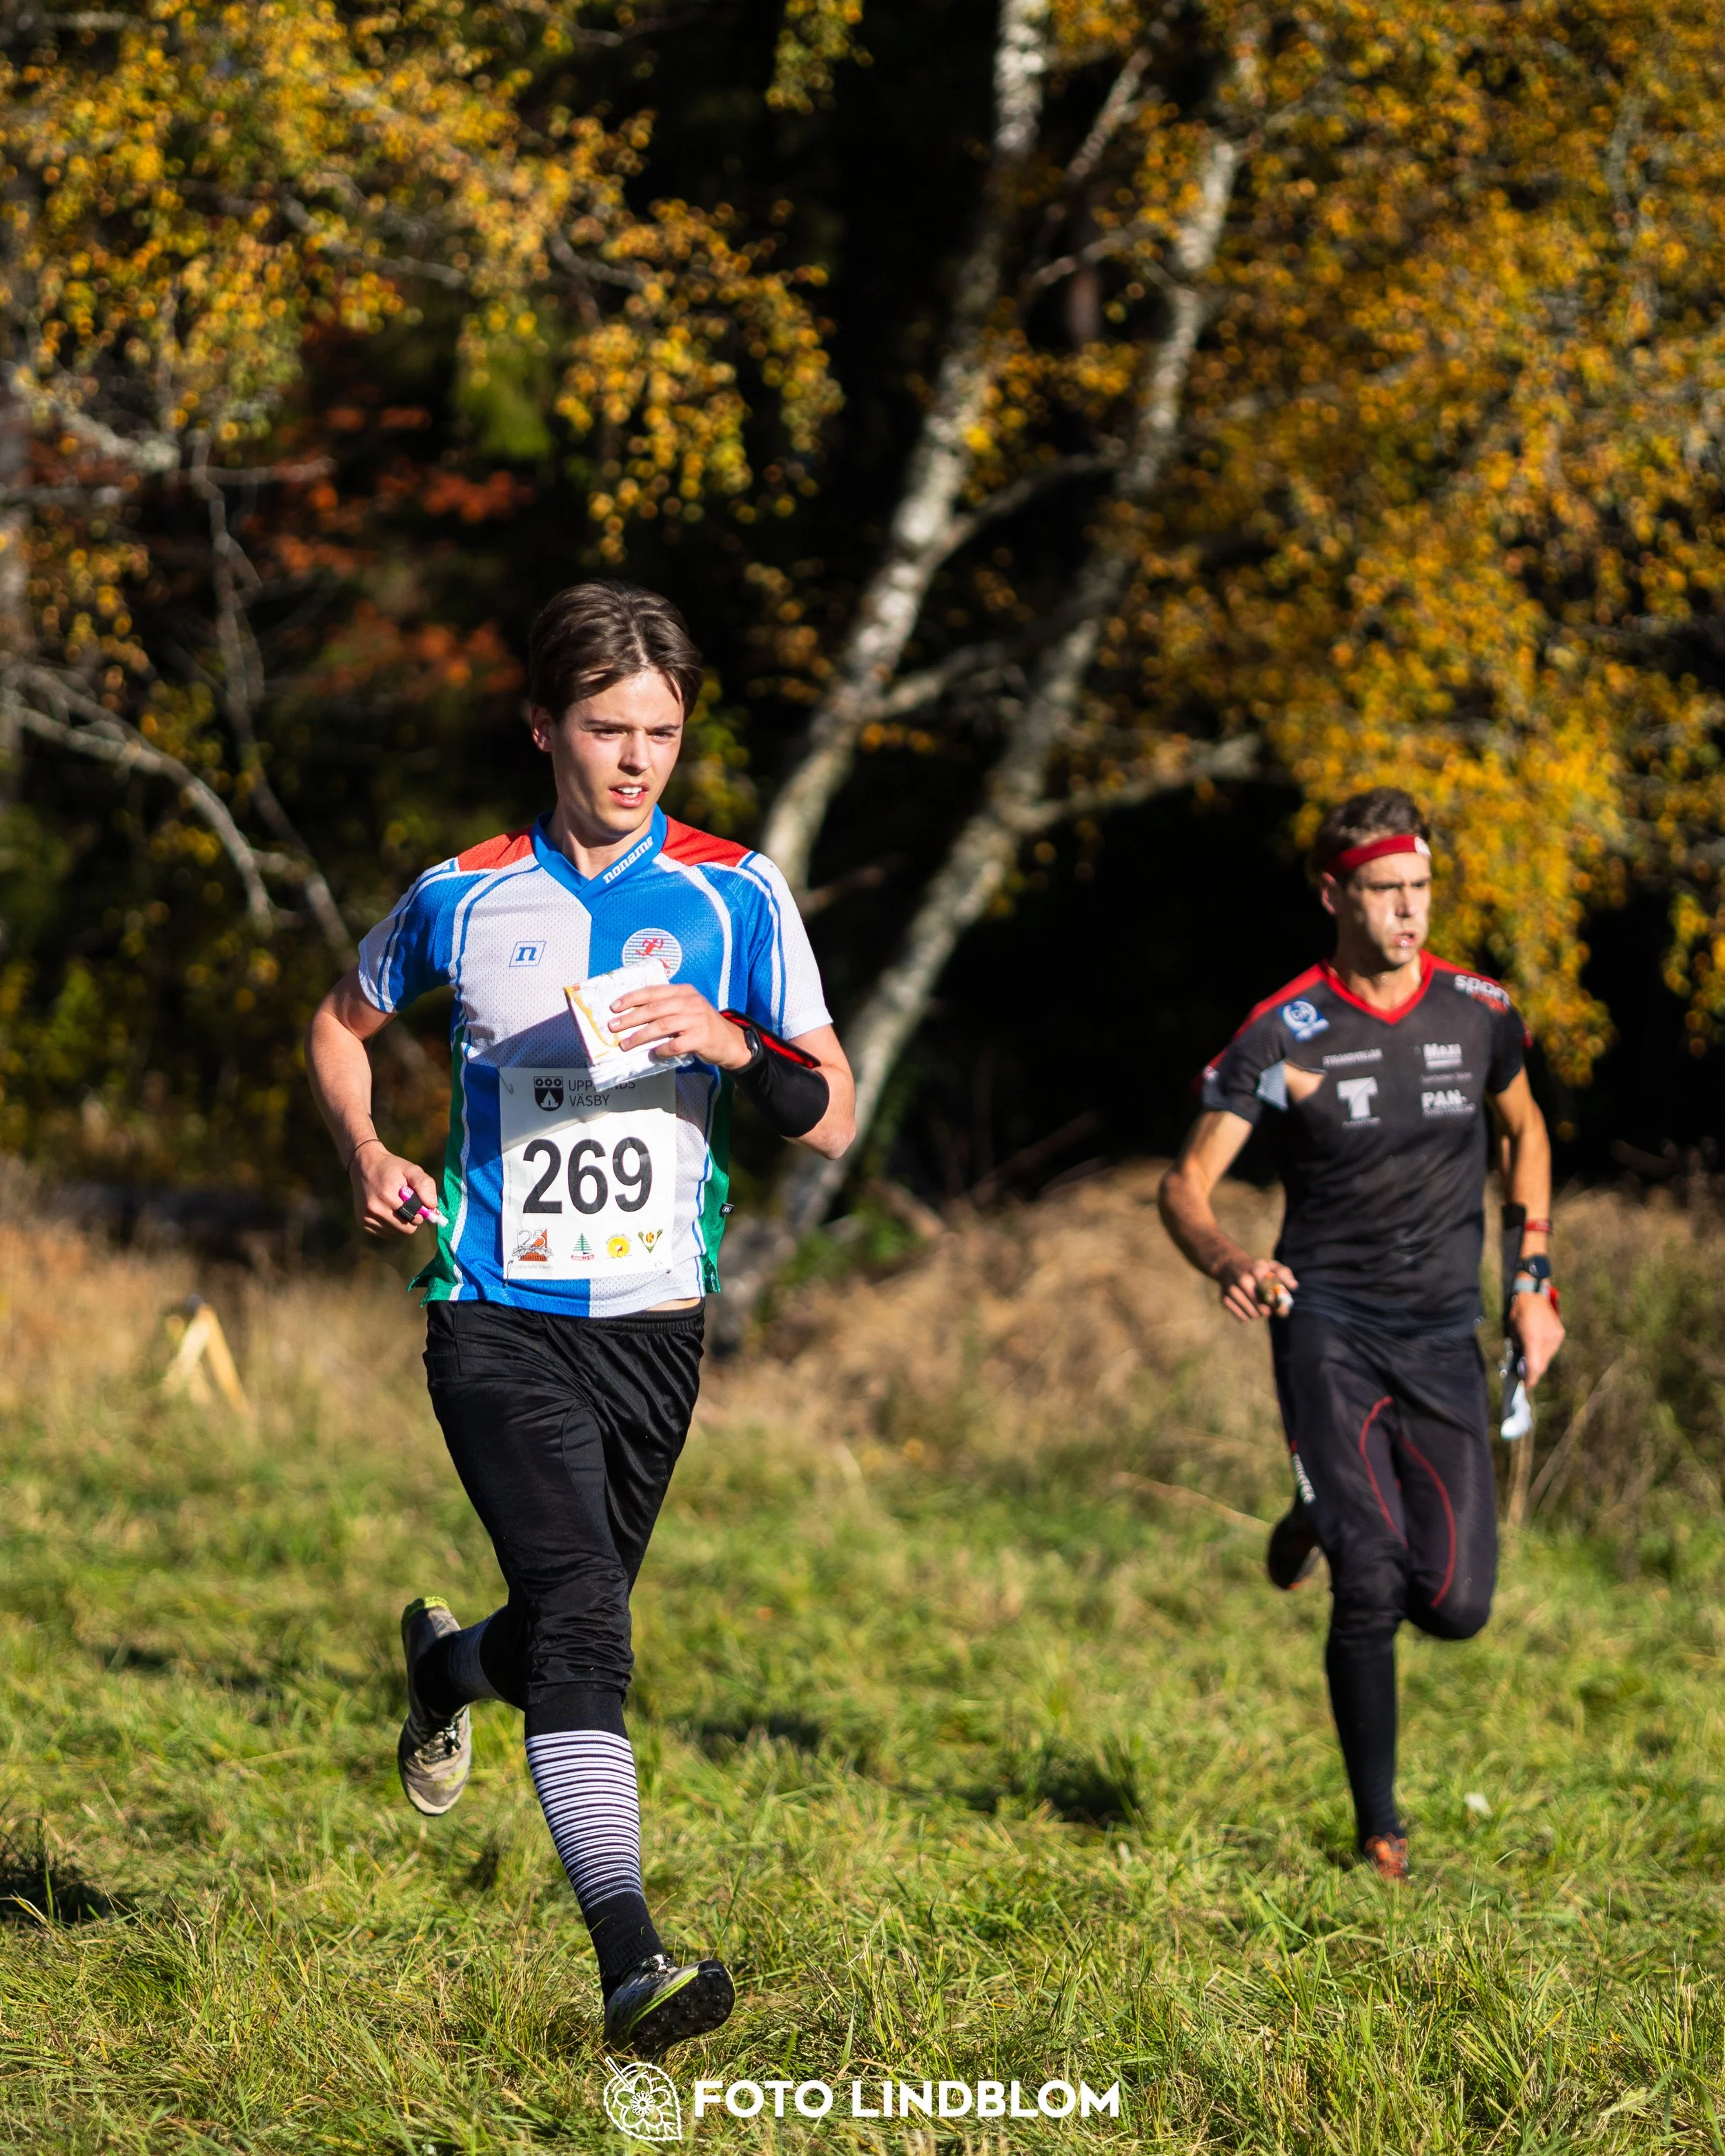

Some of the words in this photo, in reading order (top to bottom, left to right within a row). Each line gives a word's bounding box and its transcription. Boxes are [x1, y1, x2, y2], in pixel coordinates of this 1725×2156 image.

[602, 835, 653, 884] noname
[568, 1079, 635, 1091] UPPNDS
[569, 1093, 610, 1107] VÄSBY
[522, 1137, 653, 1214] 269
[518, 1229, 546, 1247] 25
